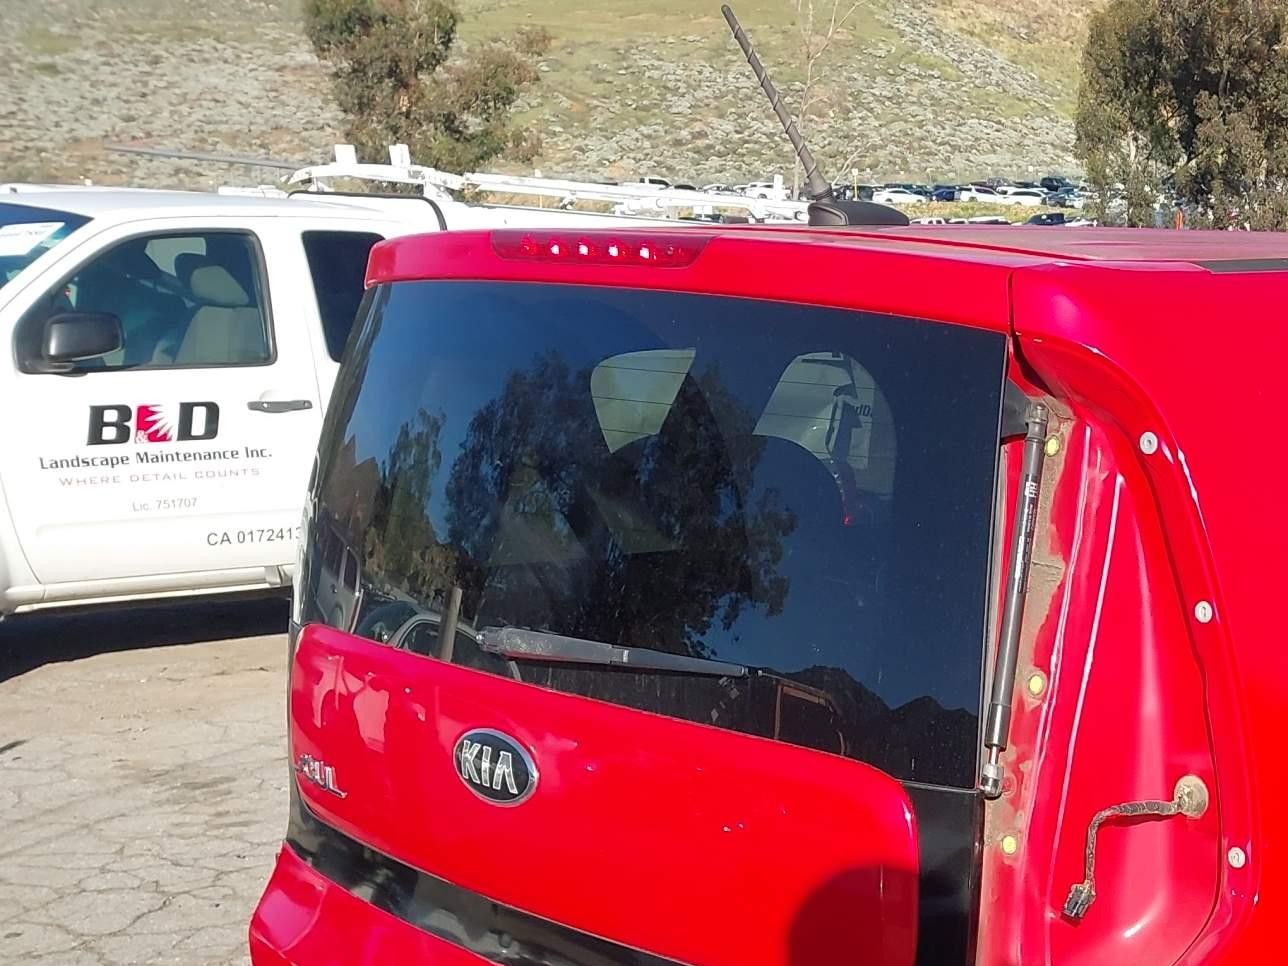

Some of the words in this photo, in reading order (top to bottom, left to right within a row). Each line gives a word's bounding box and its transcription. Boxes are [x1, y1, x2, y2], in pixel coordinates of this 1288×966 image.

[39, 455, 130, 470] Landscape
[135, 450, 240, 464] Maintenance
[244, 446, 272, 458] Inc.
[58, 475, 121, 487] WHERE
[129, 471, 188, 482] DETAIL
[194, 467, 260, 480] COUNTS
[155, 497, 198, 510] 751707
[207, 531, 232, 546] CA
[461, 739, 519, 795] KIA
